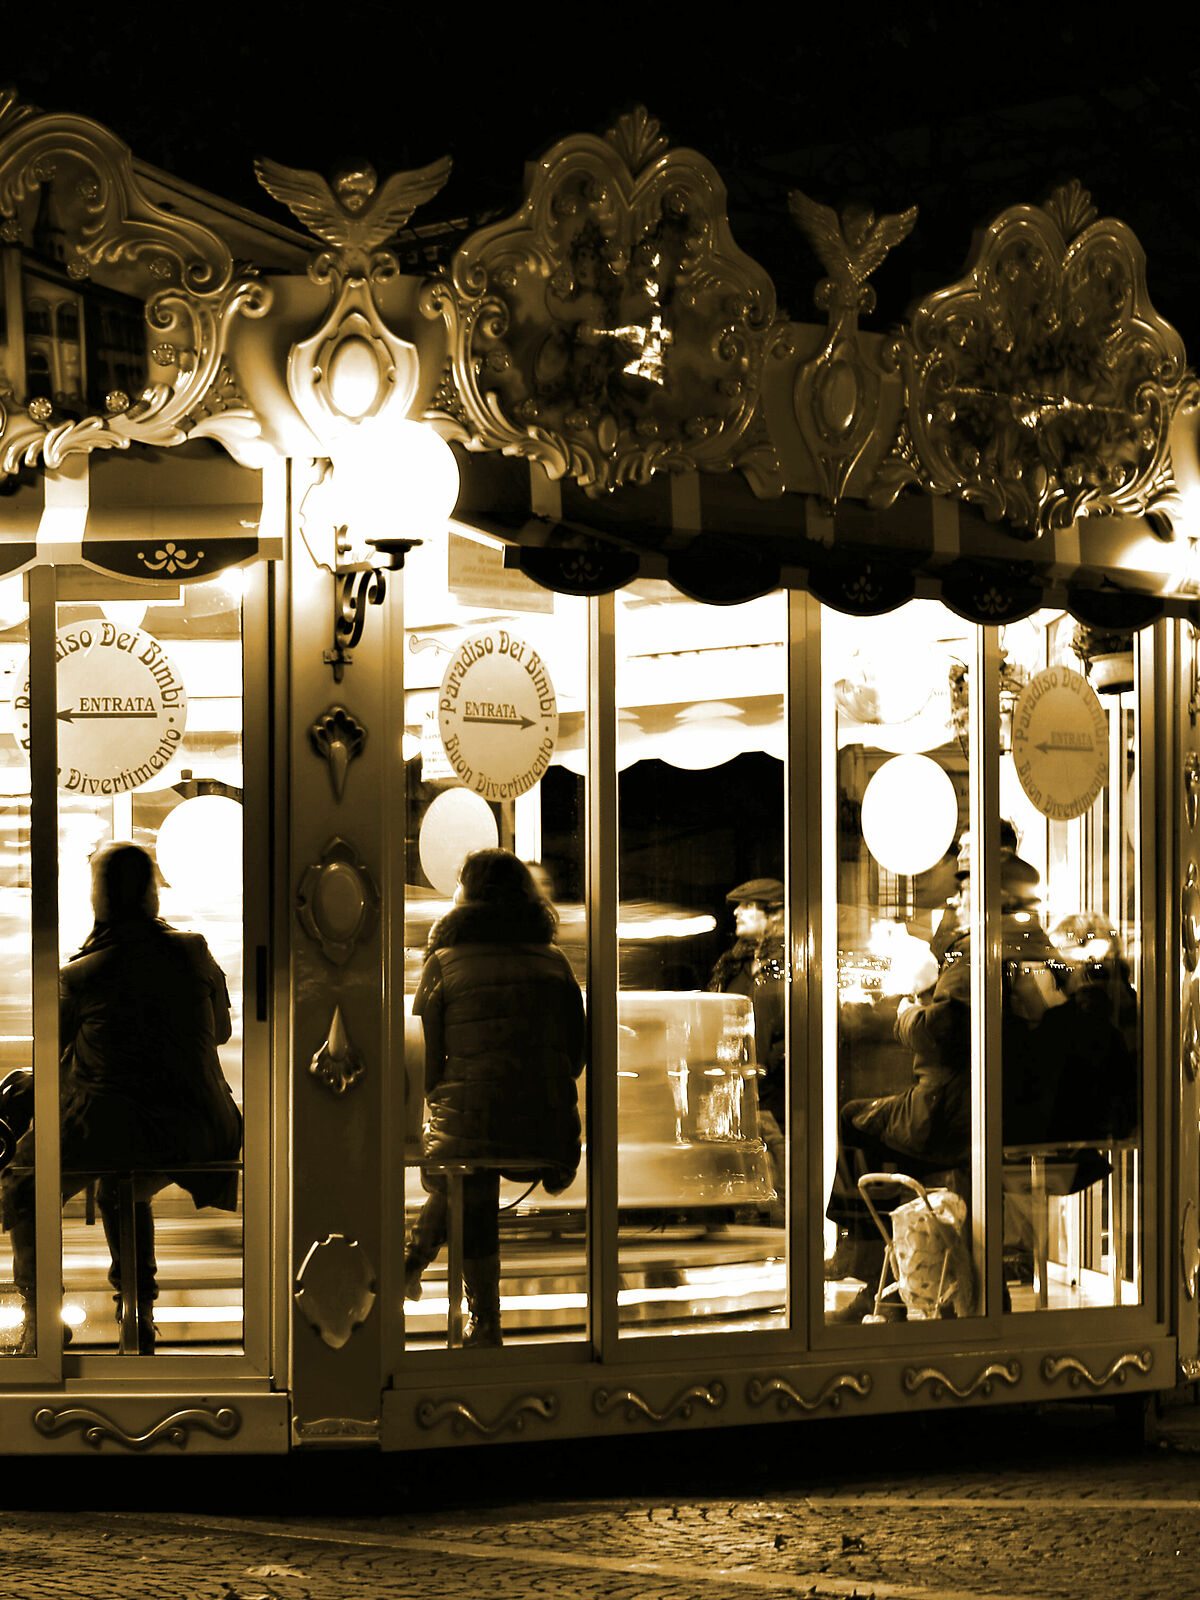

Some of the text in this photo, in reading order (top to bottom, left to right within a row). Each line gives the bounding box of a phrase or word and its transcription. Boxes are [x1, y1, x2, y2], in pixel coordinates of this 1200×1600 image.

[100, 622, 140, 653] Dei
[138, 641, 184, 710] Bimbi
[440, 630, 556, 718] Paradiso Dei Bimbi
[80, 697, 156, 712] ENTRATA
[465, 701, 517, 718] ENTRATA
[1015, 672, 1058, 742] Paradiso
[1062, 667, 1083, 695] Dei
[65, 729, 182, 794] Divertimento
[445, 733, 554, 798] Buon Divertimento
[1050, 731, 1094, 746] ENTRATA
[1018, 760, 1042, 804] Buon
